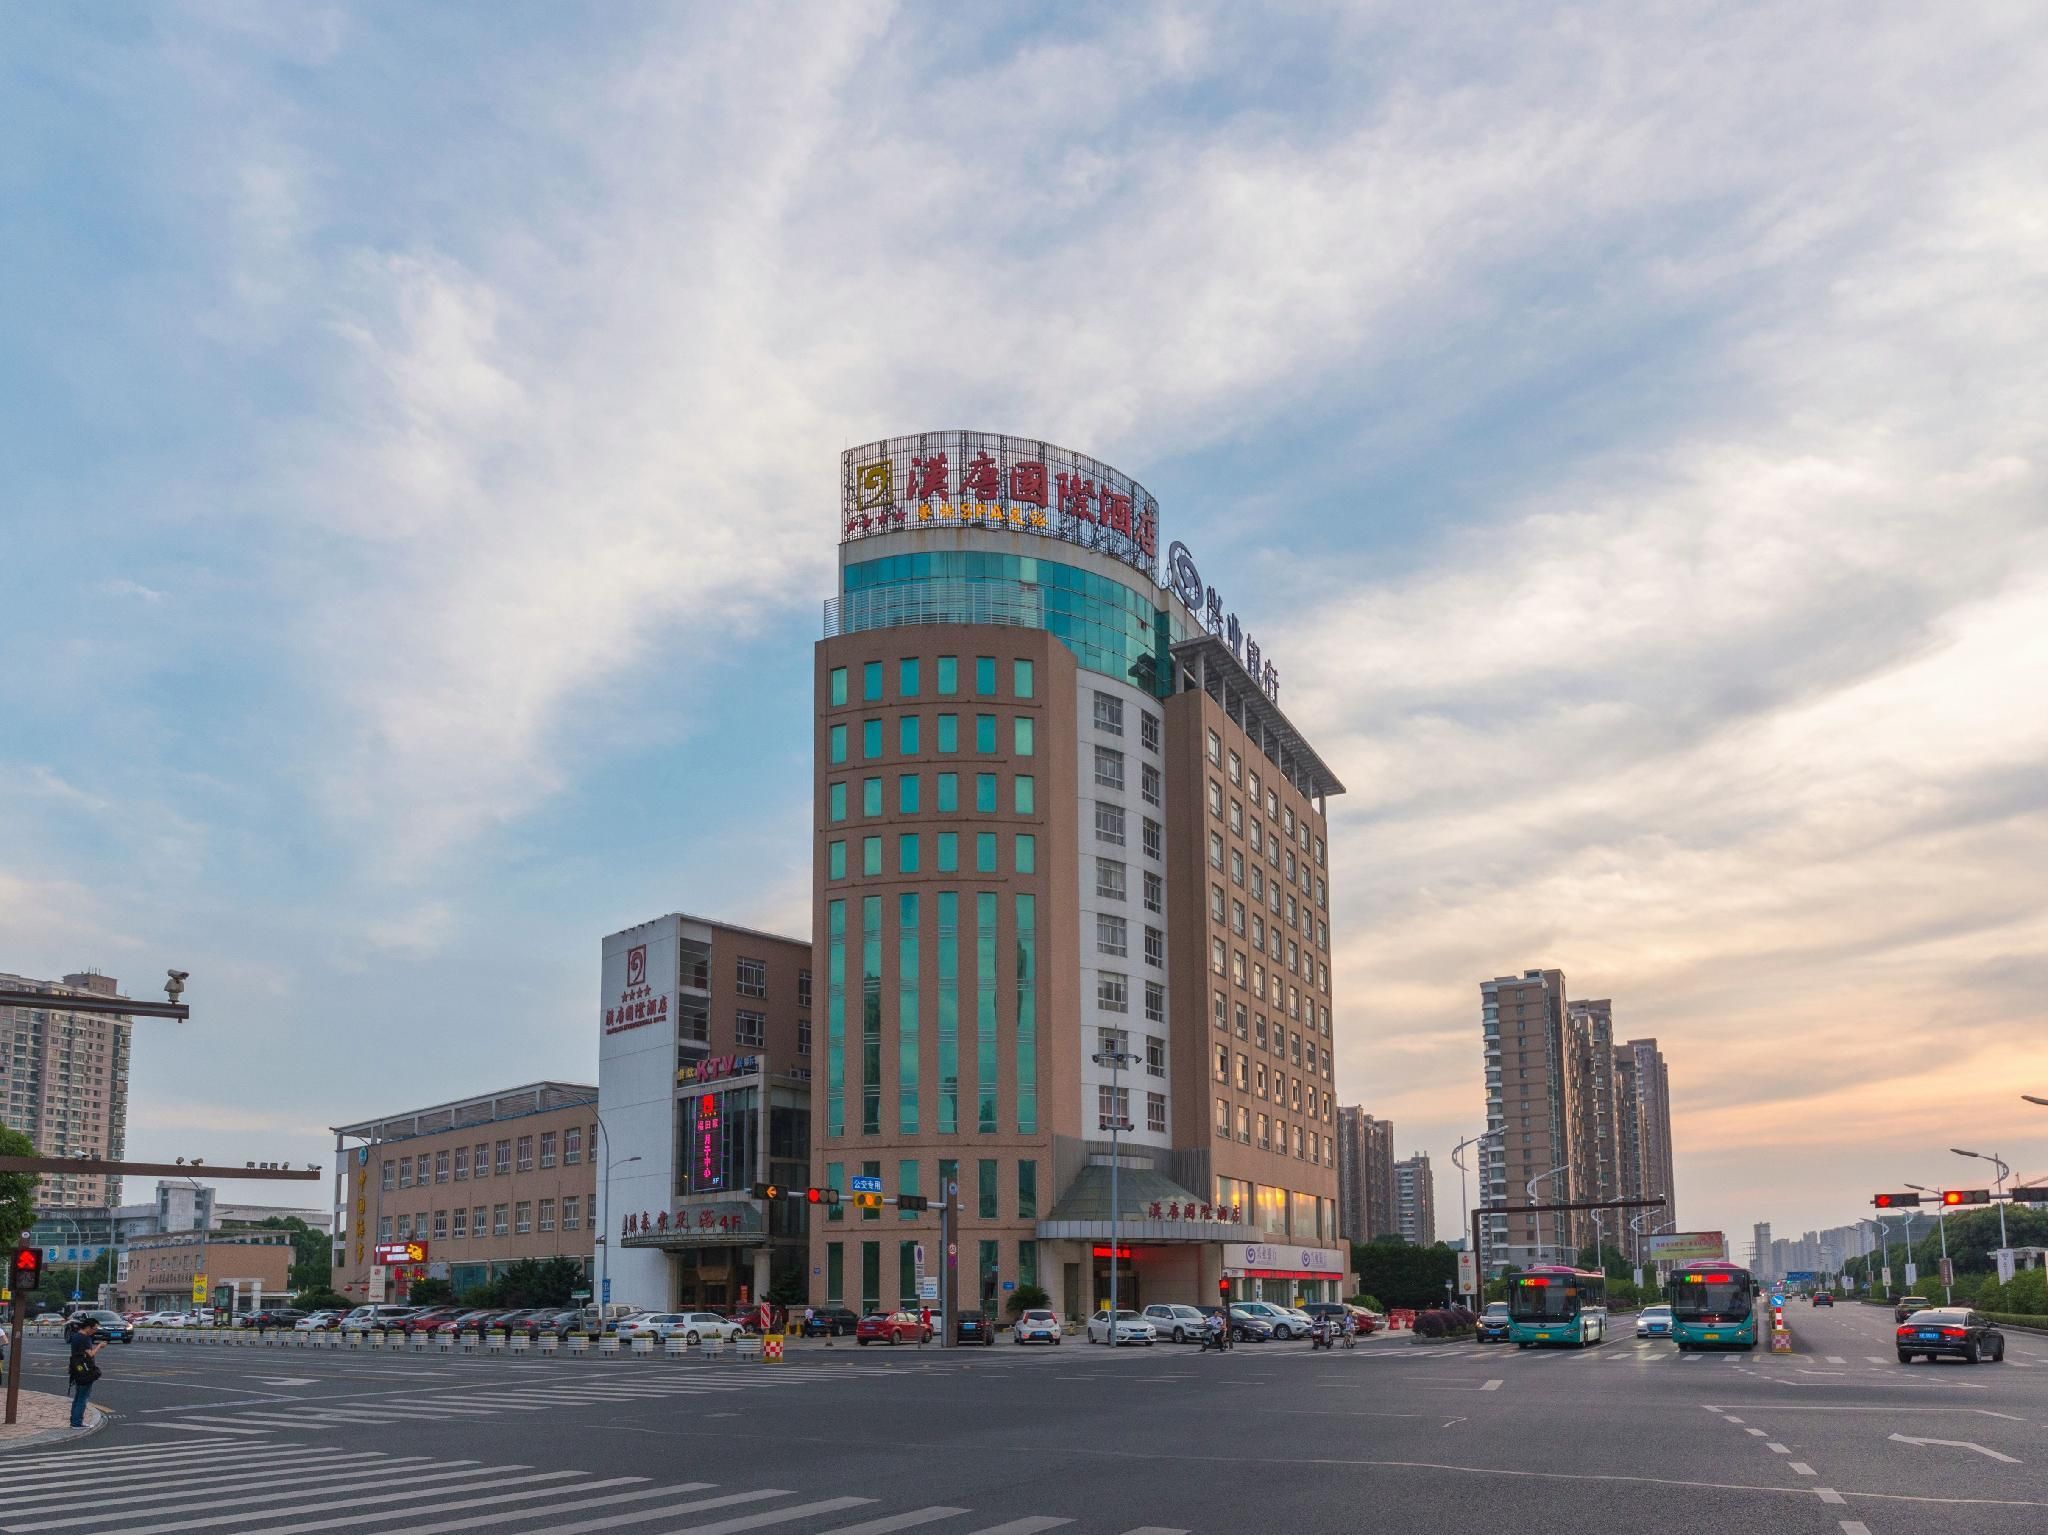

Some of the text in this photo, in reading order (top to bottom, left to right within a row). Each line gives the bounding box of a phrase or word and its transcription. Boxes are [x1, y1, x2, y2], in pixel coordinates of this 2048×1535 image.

[696, 1054, 736, 1083] KTV
[704, 1134, 712, 1178] 月子中心
[854, 1180, 881, 1191] 公交专用
[720, 1216, 741, 1231] 4F
